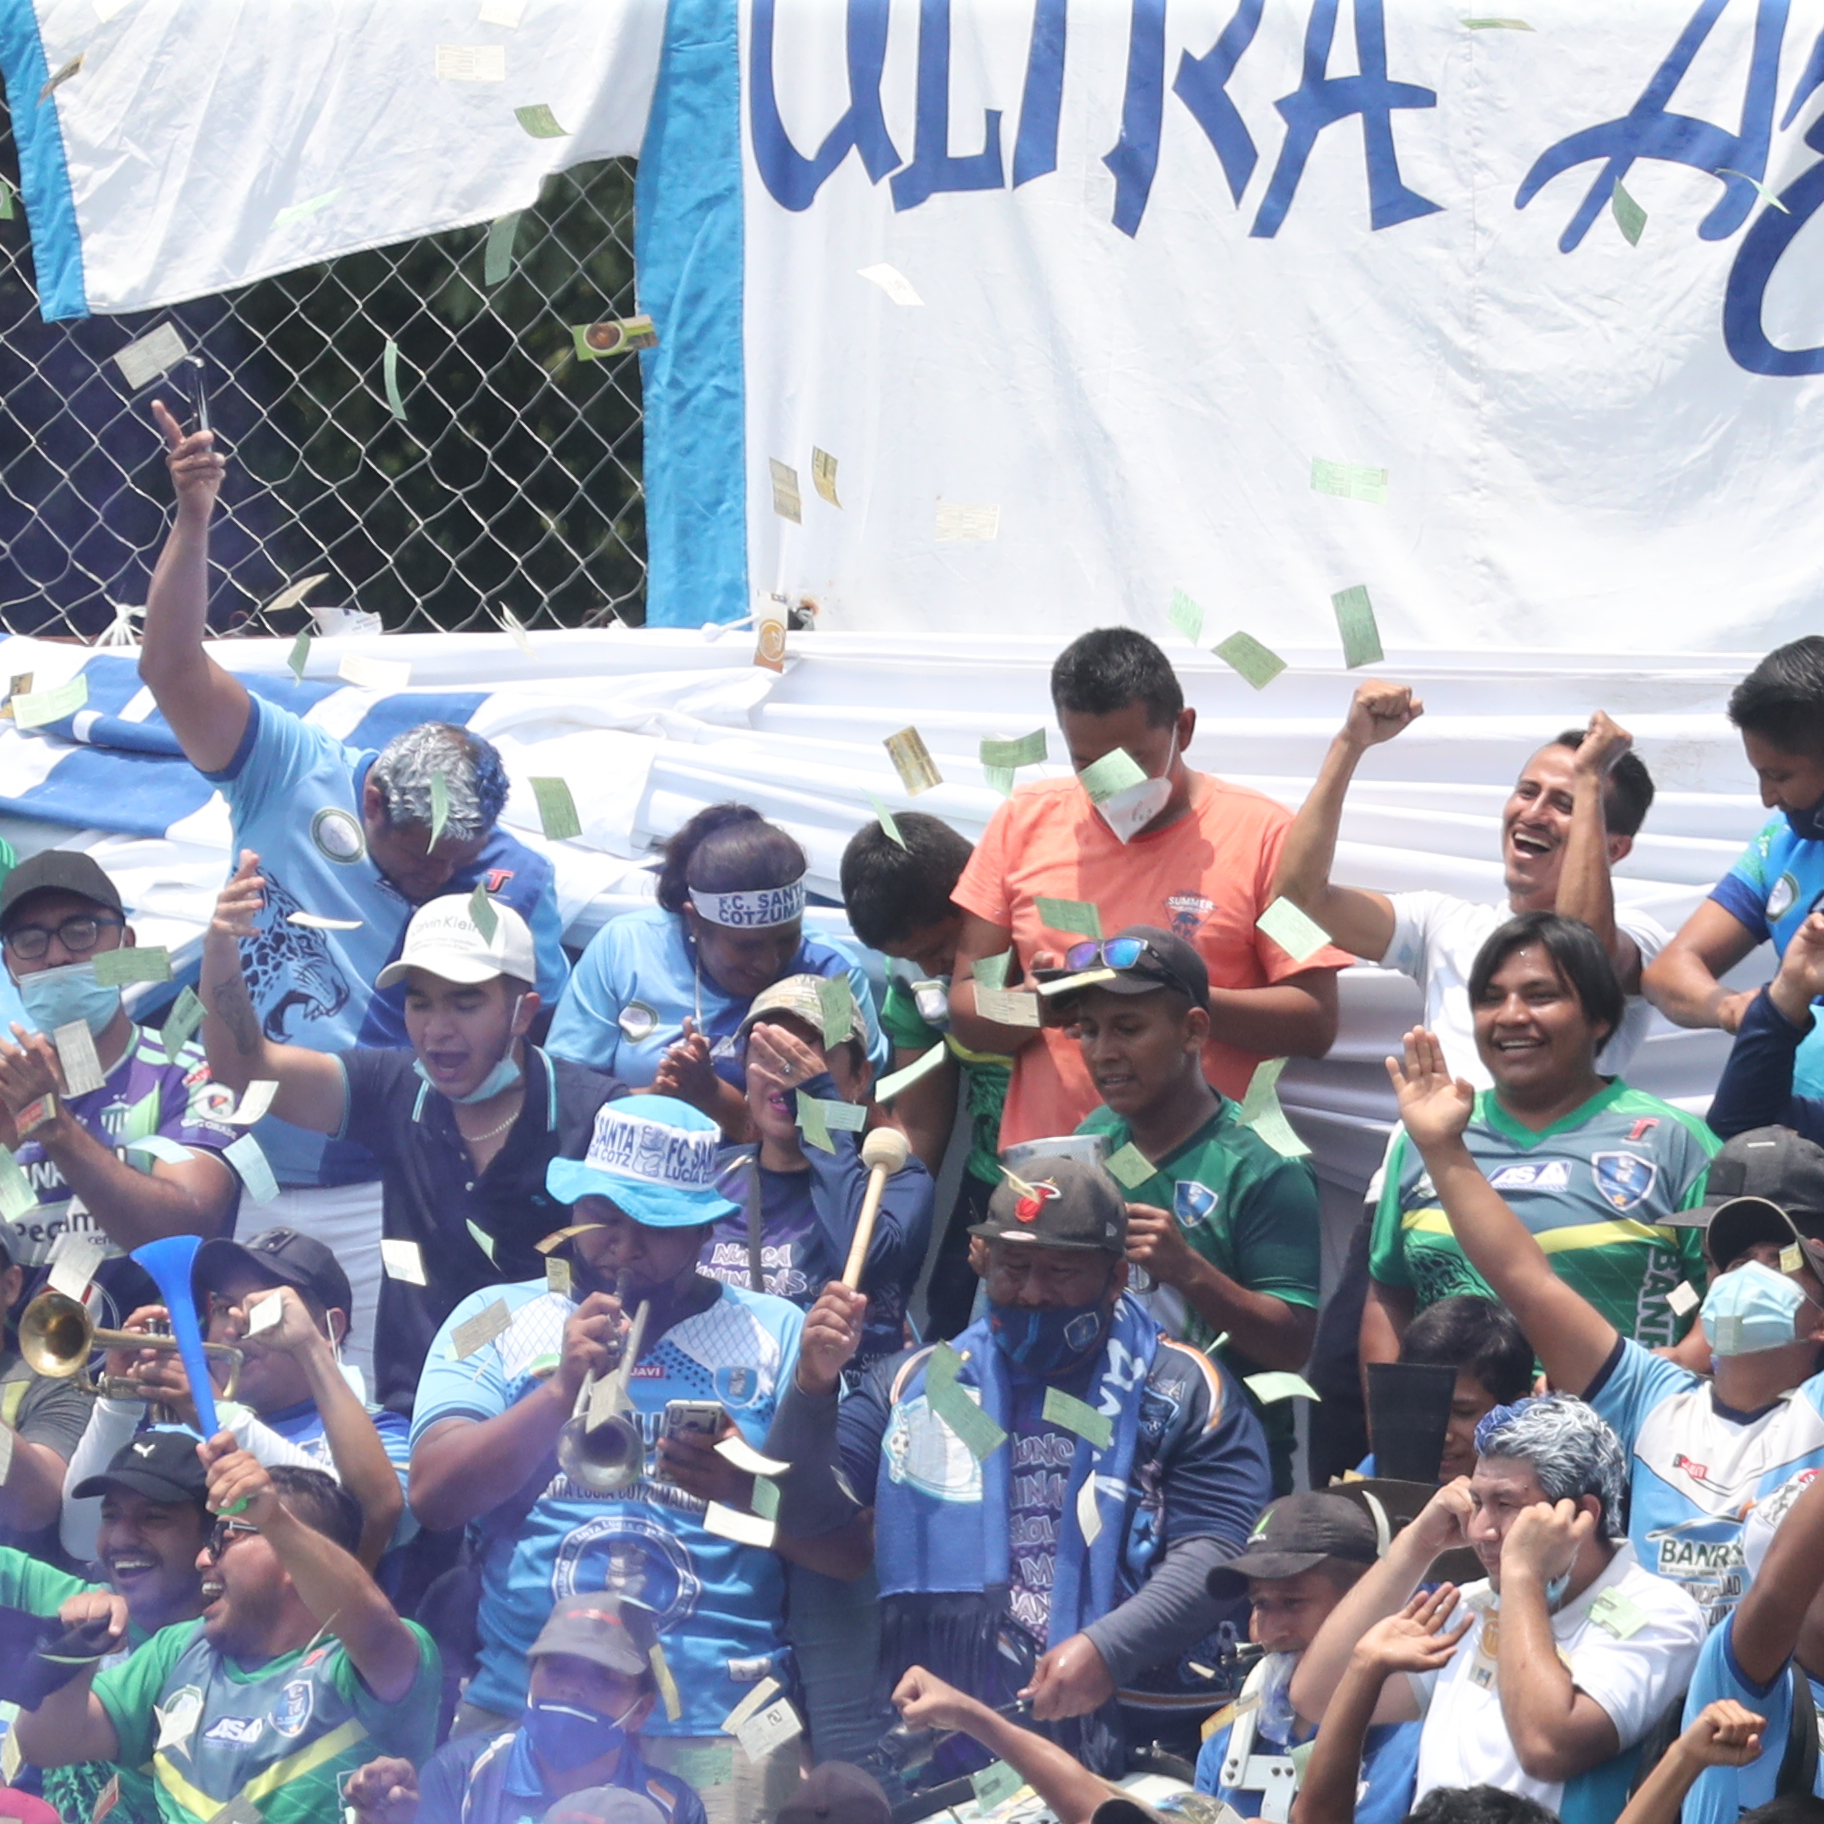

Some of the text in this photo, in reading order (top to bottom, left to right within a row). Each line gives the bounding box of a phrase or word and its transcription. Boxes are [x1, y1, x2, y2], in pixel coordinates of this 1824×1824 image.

[1168, 896, 1214, 911] SUMMER
[666, 1138, 687, 1165] FC
[663, 1161, 698, 1183] LUCIA
[1493, 1160, 1570, 1189] ASA
[710, 1242, 793, 1269] NUCA
[630, 1366, 661, 1378] JAVI
[204, 1717, 264, 1743] ASA
